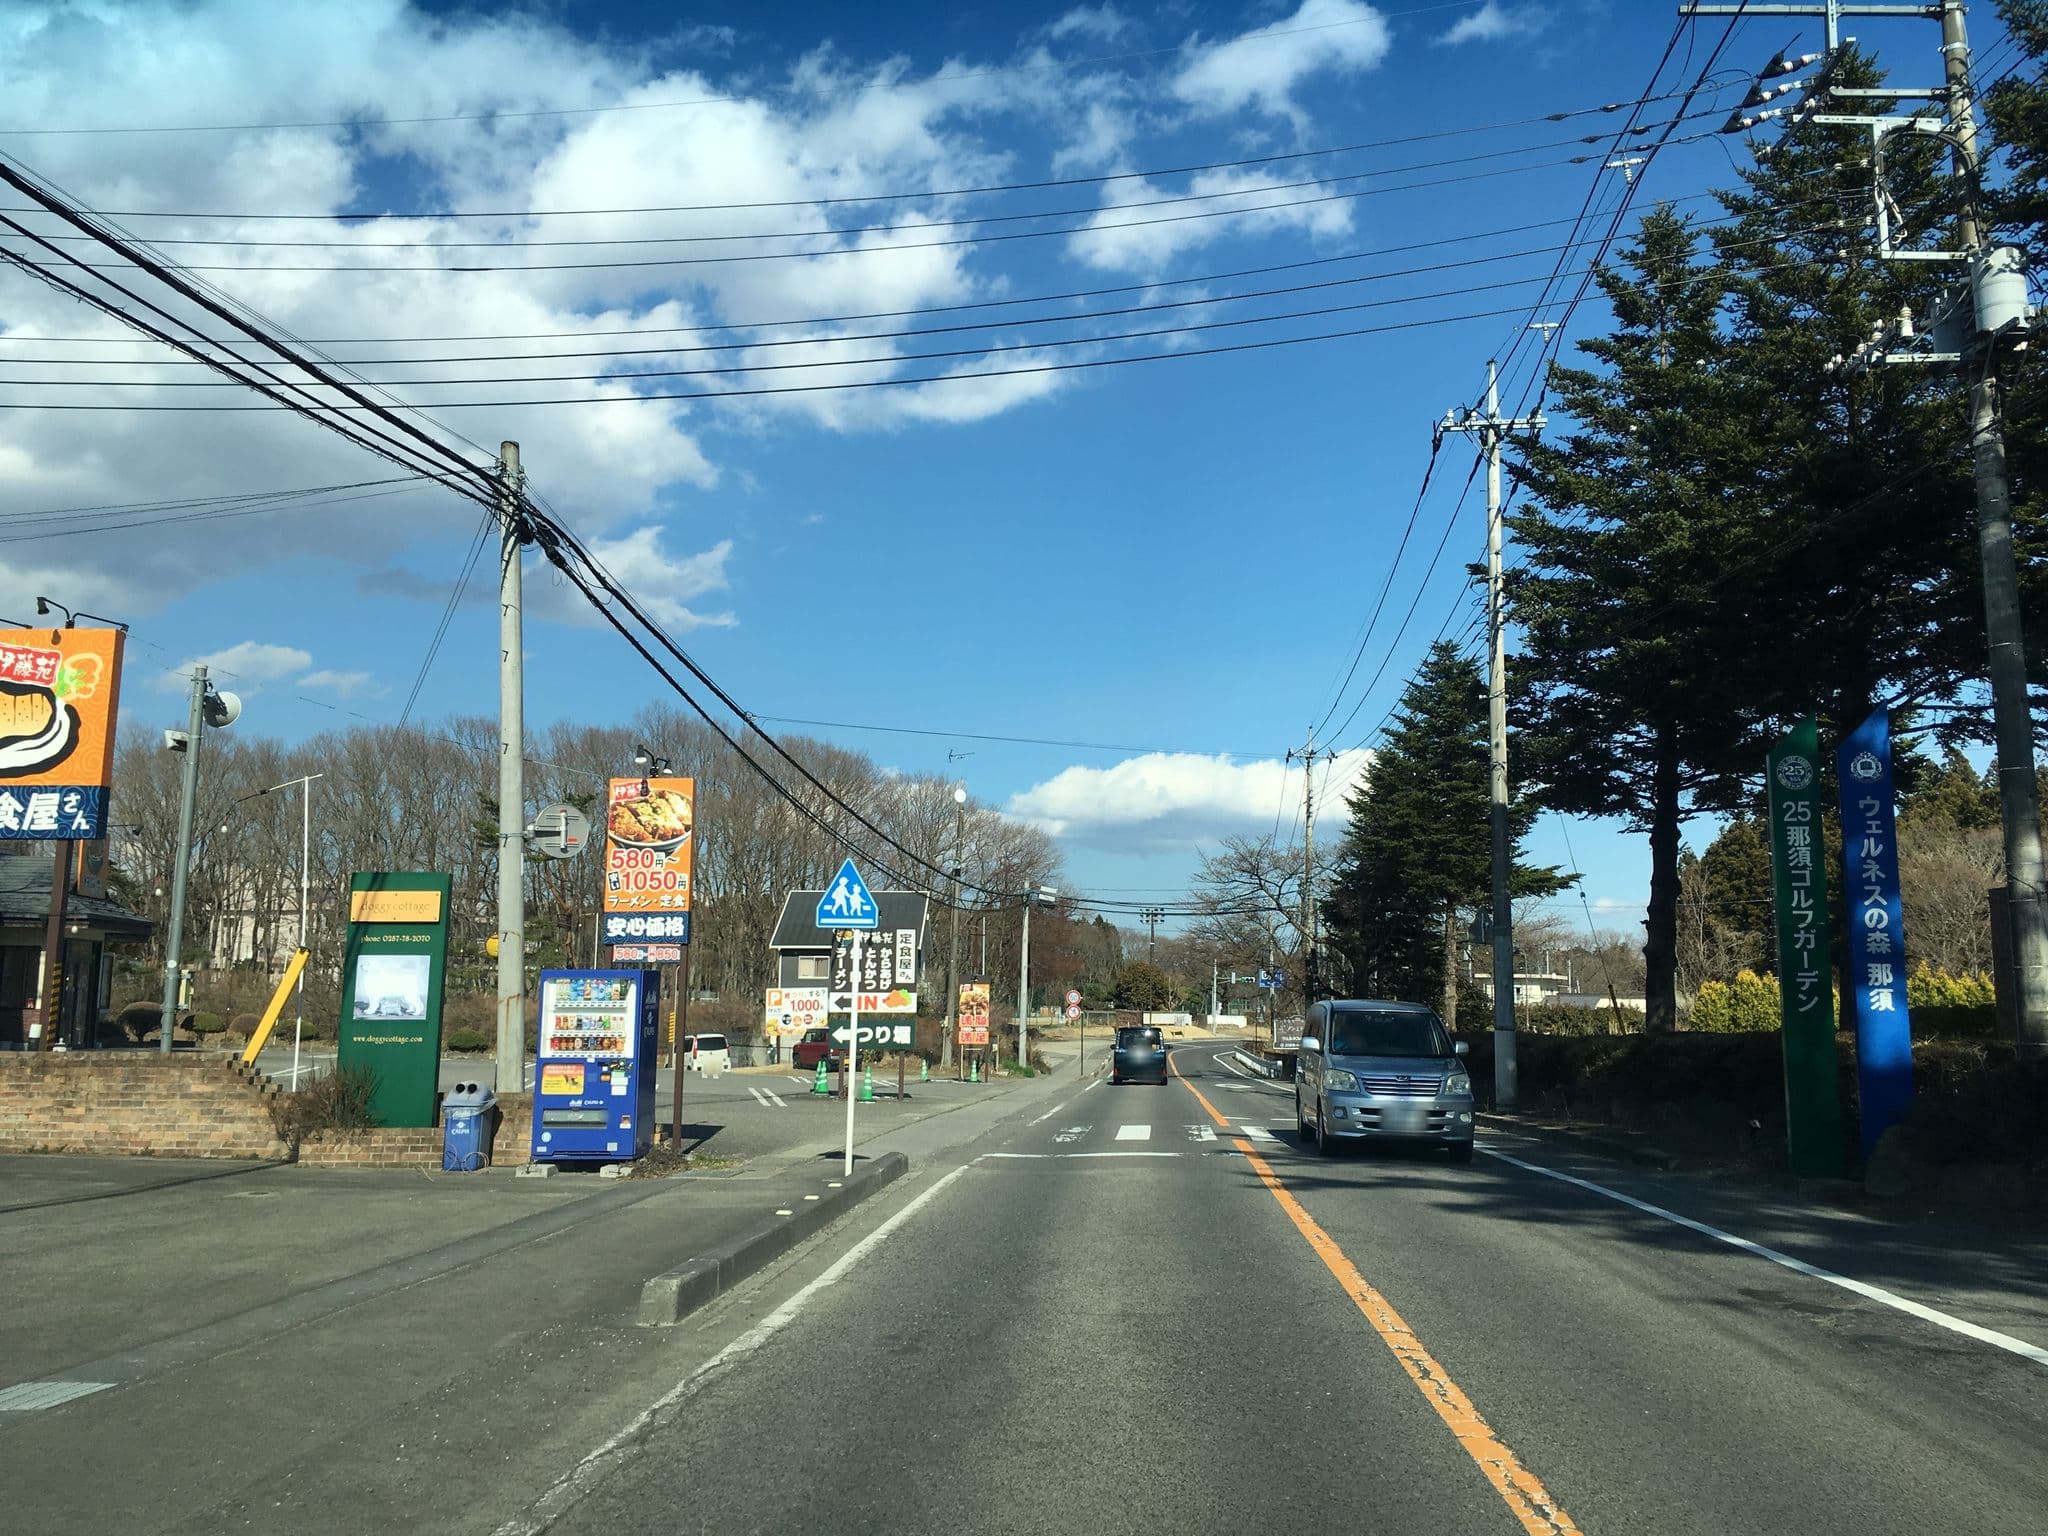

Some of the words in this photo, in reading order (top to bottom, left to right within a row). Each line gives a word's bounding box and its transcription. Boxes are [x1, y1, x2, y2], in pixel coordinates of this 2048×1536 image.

[607, 917, 684, 937] 安心価格
[835, 948, 846, 989] ラーメン
[865, 947, 877, 990] とんかつ
[857, 996, 877, 1010] IN
